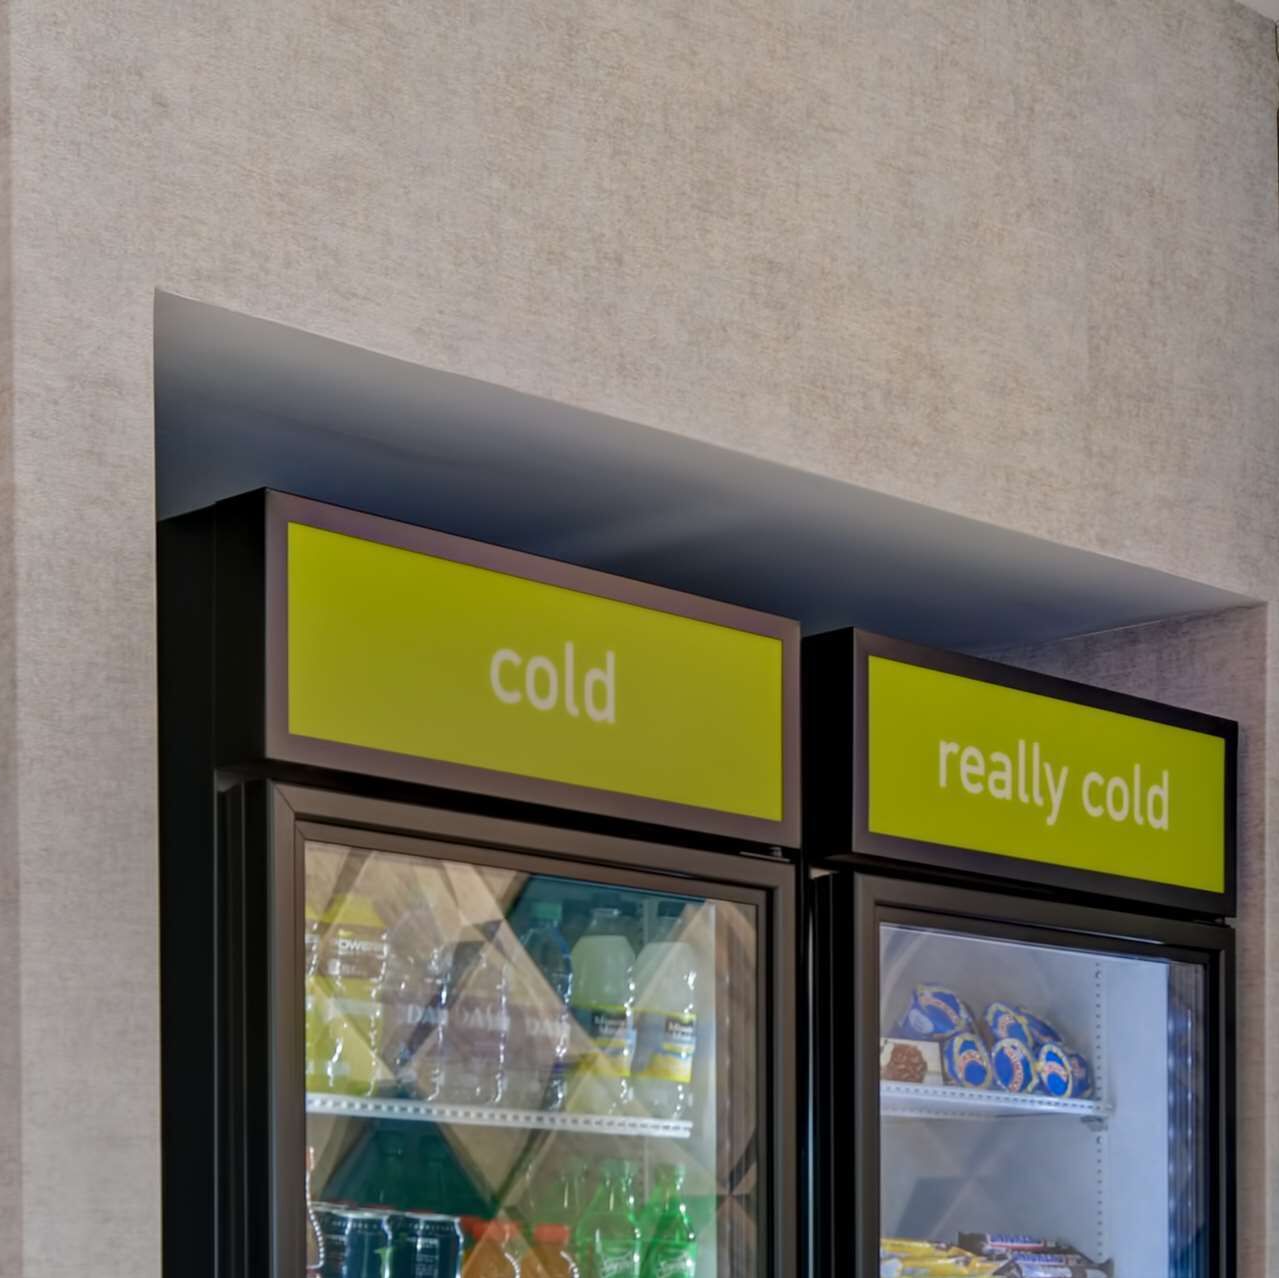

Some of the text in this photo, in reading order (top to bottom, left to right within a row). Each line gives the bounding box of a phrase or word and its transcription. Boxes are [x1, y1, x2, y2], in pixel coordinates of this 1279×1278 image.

[489, 641, 616, 724] cold
[938, 735, 1169, 831] really cold
